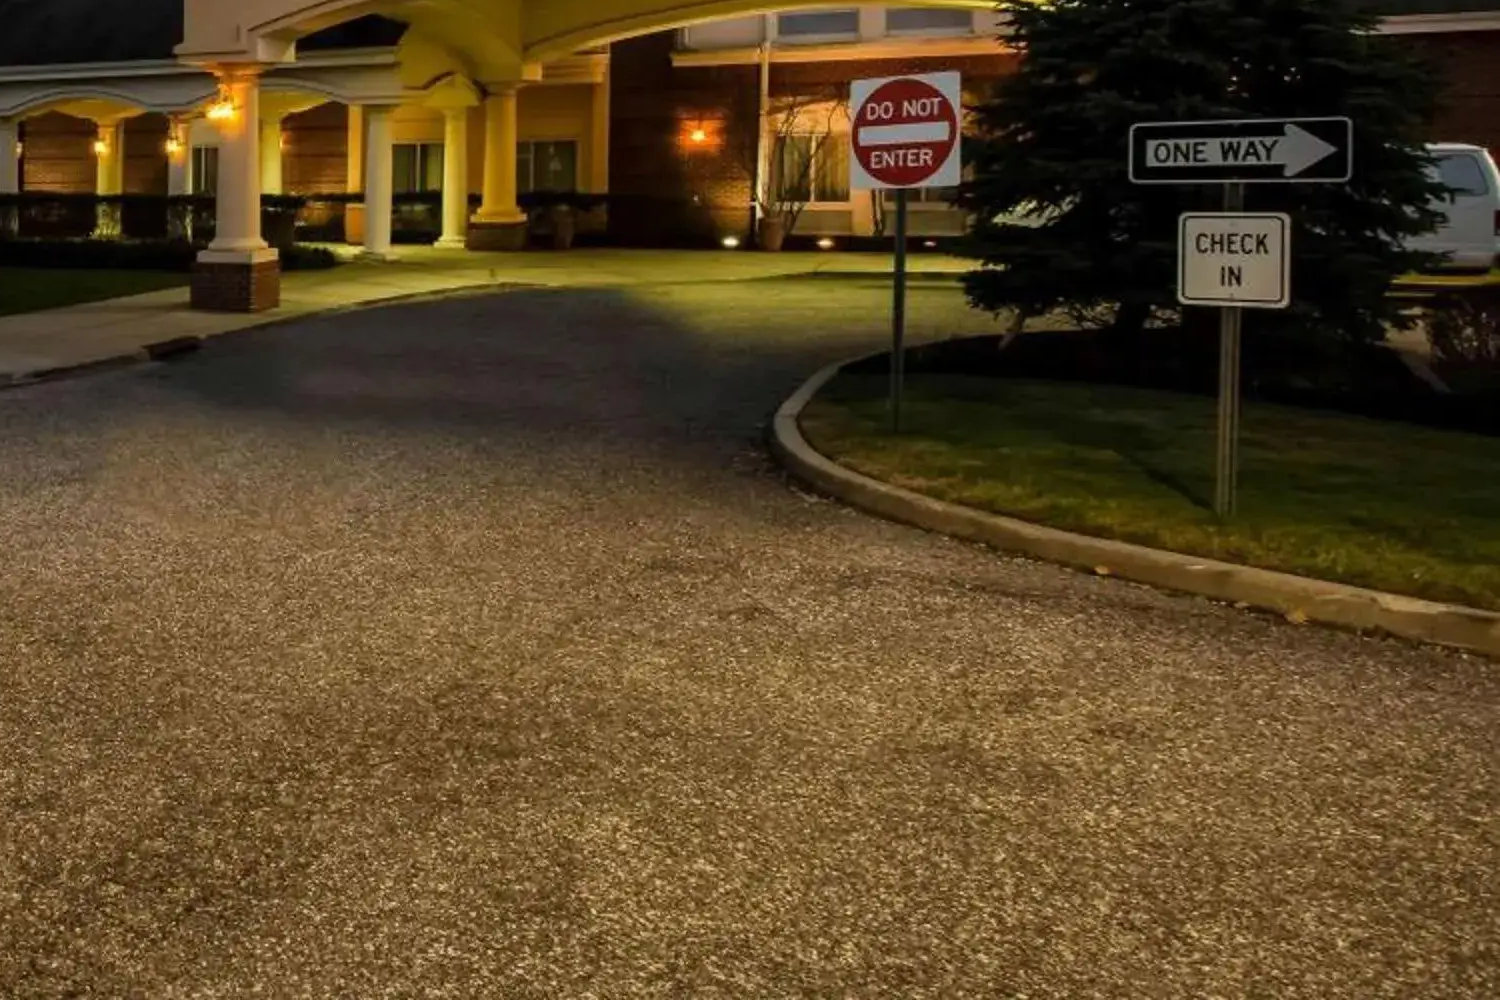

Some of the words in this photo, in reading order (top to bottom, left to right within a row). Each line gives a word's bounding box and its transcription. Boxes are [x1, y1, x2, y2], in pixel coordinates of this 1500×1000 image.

[866, 102, 893, 120] DO
[902, 98, 942, 117] NOT
[870, 149, 933, 169] ENTER
[1154, 142, 1208, 163] ONE
[1220, 139, 1279, 162] WAY
[1195, 233, 1269, 255] CHECK
[1220, 265, 1242, 287] IN
